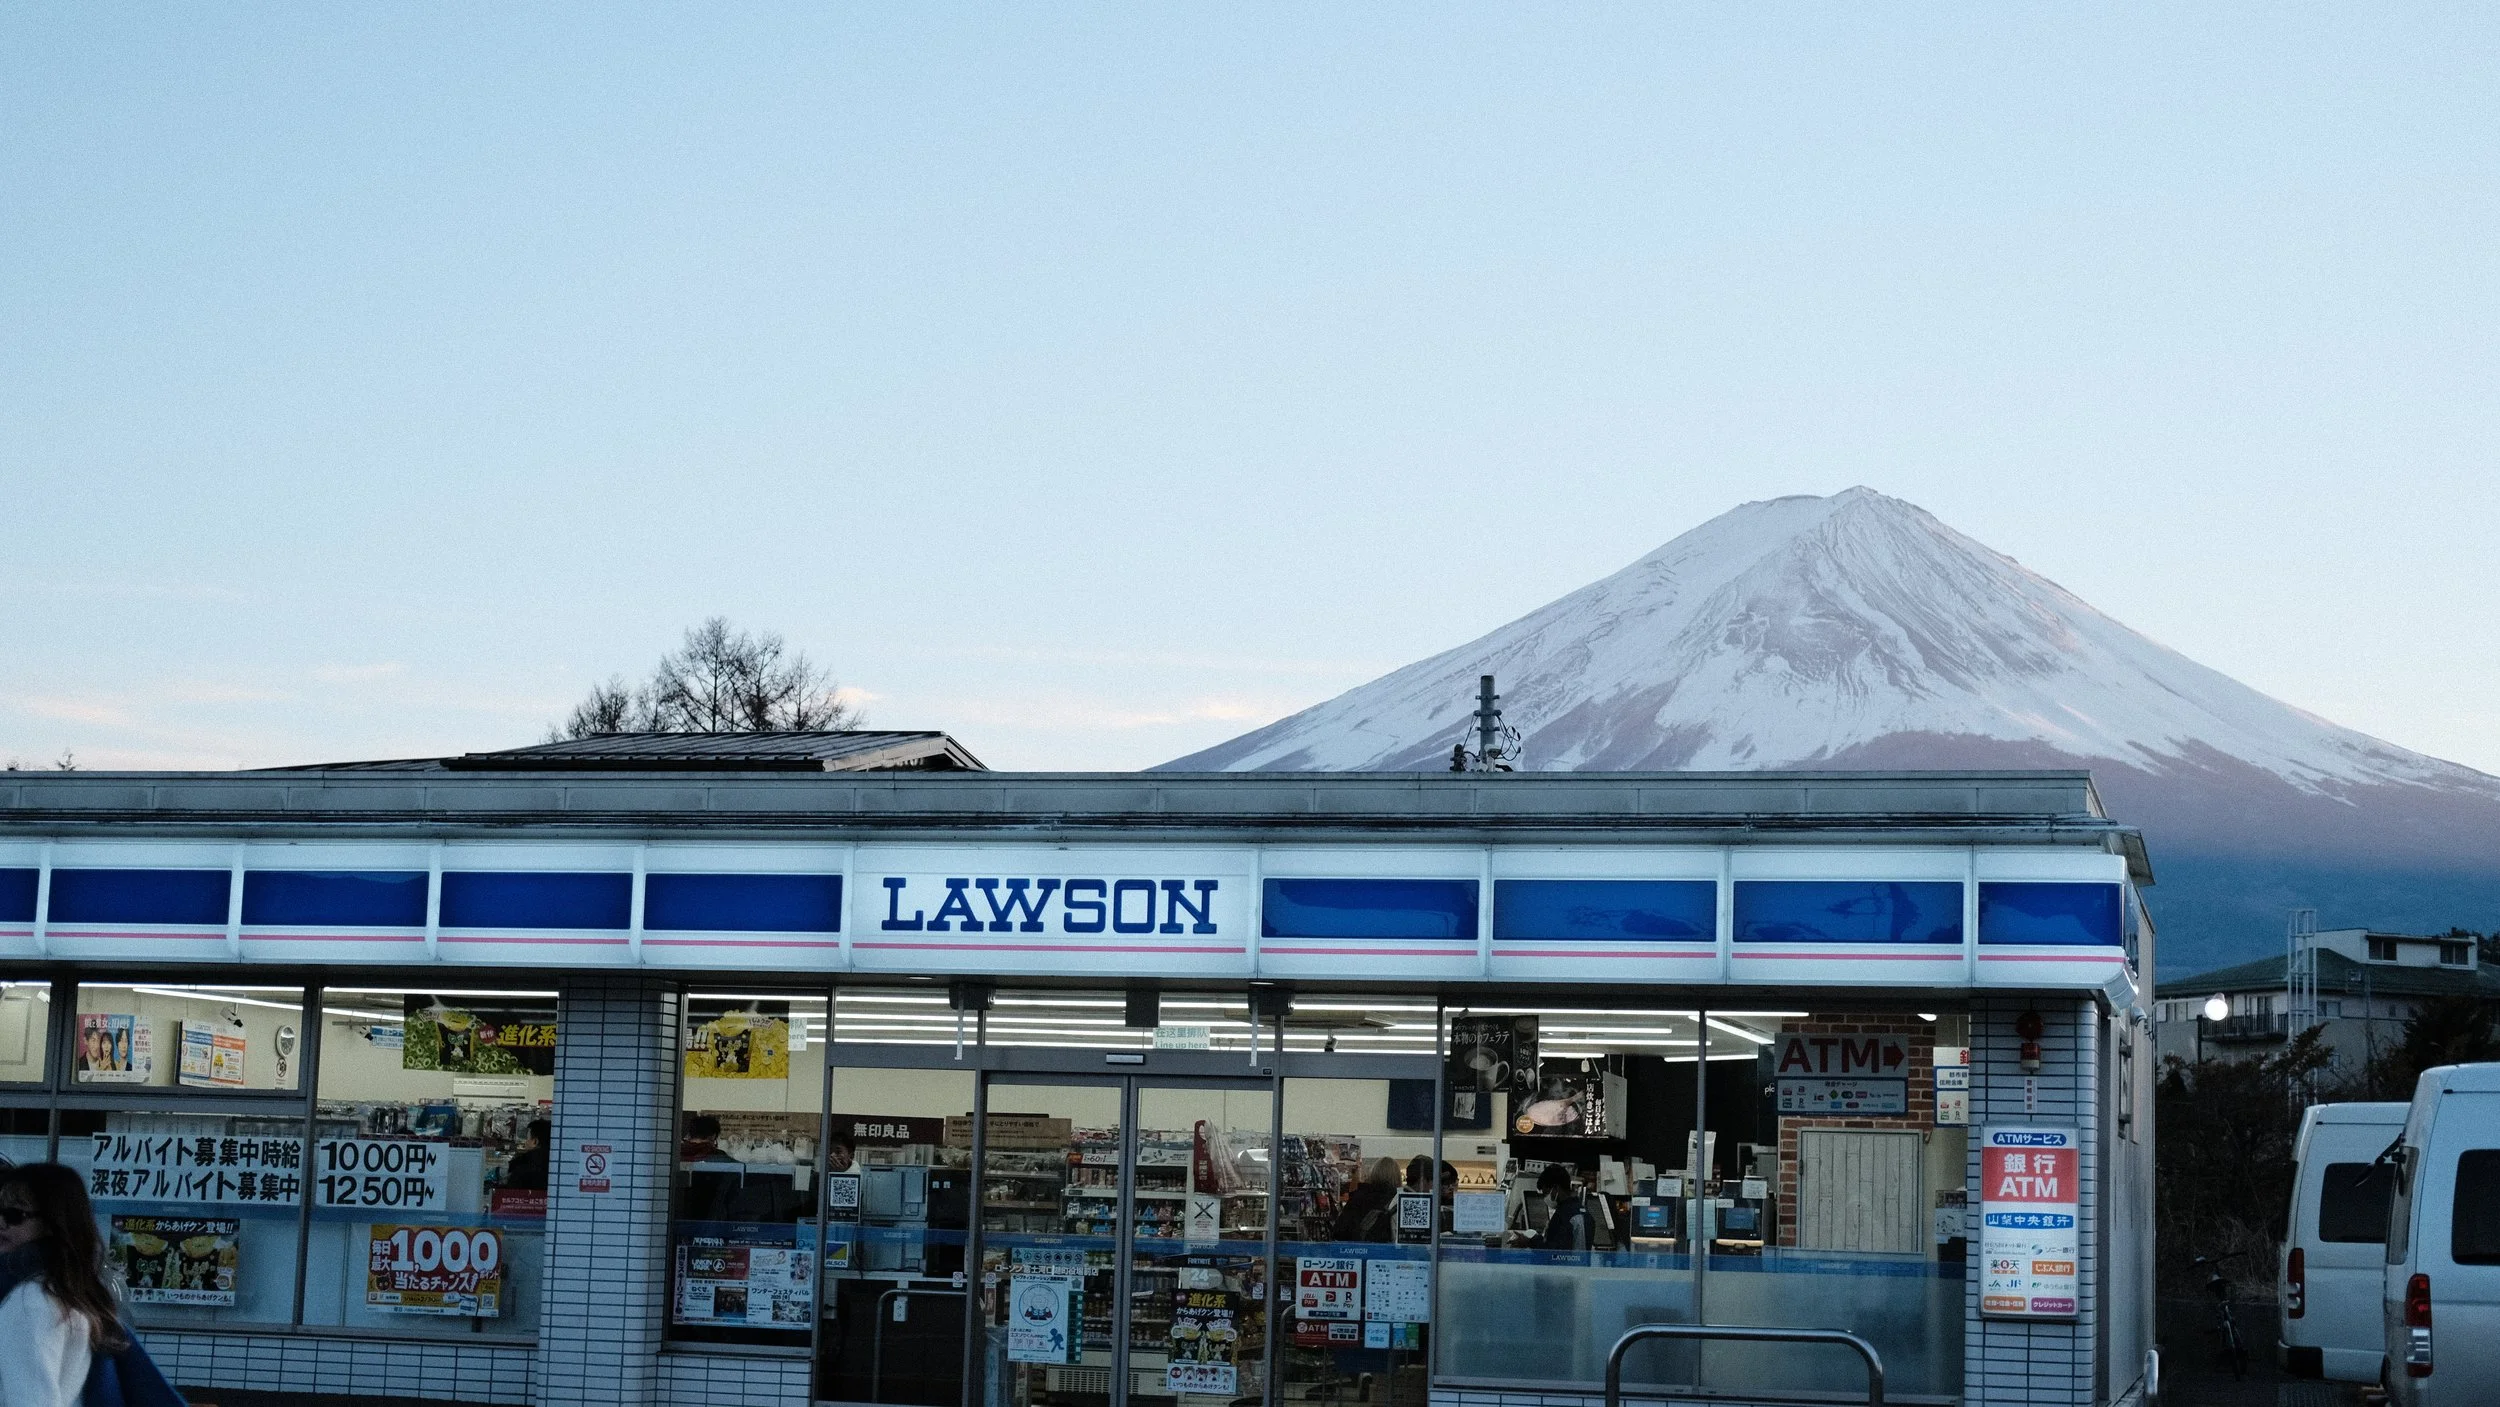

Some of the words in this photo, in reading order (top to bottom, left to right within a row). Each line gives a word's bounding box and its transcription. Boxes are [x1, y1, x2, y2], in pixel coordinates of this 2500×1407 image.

[881, 877, 1218, 934] LAWSON
[498, 1024, 556, 1048] 進化系
[1156, 1028, 1208, 1038] 在这里排队
[1778, 1038, 1880, 1074] ATM
[1584, 1083, 1594, 1135] 店炊きごはん
[853, 1122, 910, 1140] 無印良品
[1996, 1134, 2062, 1144] ATMサービス
[93, 1134, 302, 1170] アルバイト募集中時給
[2004, 1152, 2056, 1174] 銀行
[90, 1168, 300, 1202] 深夜アルバイト募集中
[1998, 1176, 2058, 1198] ATM
[1988, 1214, 2070, 1227] 山梨中央銀行
[372, 1240, 391, 1255] 毎日
[391, 1230, 499, 1273] 1,000
[371, 1256, 390, 1272] 最大
[1304, 1260, 1354, 1270] ローソン銀行
[2035, 1264, 2071, 1272] じぶん銀行
[394, 1272, 479, 1293] 当たるチャンス!
[1308, 1272, 1350, 1287] ATM
[1186, 1292, 1226, 1308] 進化系
[1176, 1308, 1234, 1318] からあげクン登場!!
[1308, 1324, 1328, 1332] ATM
